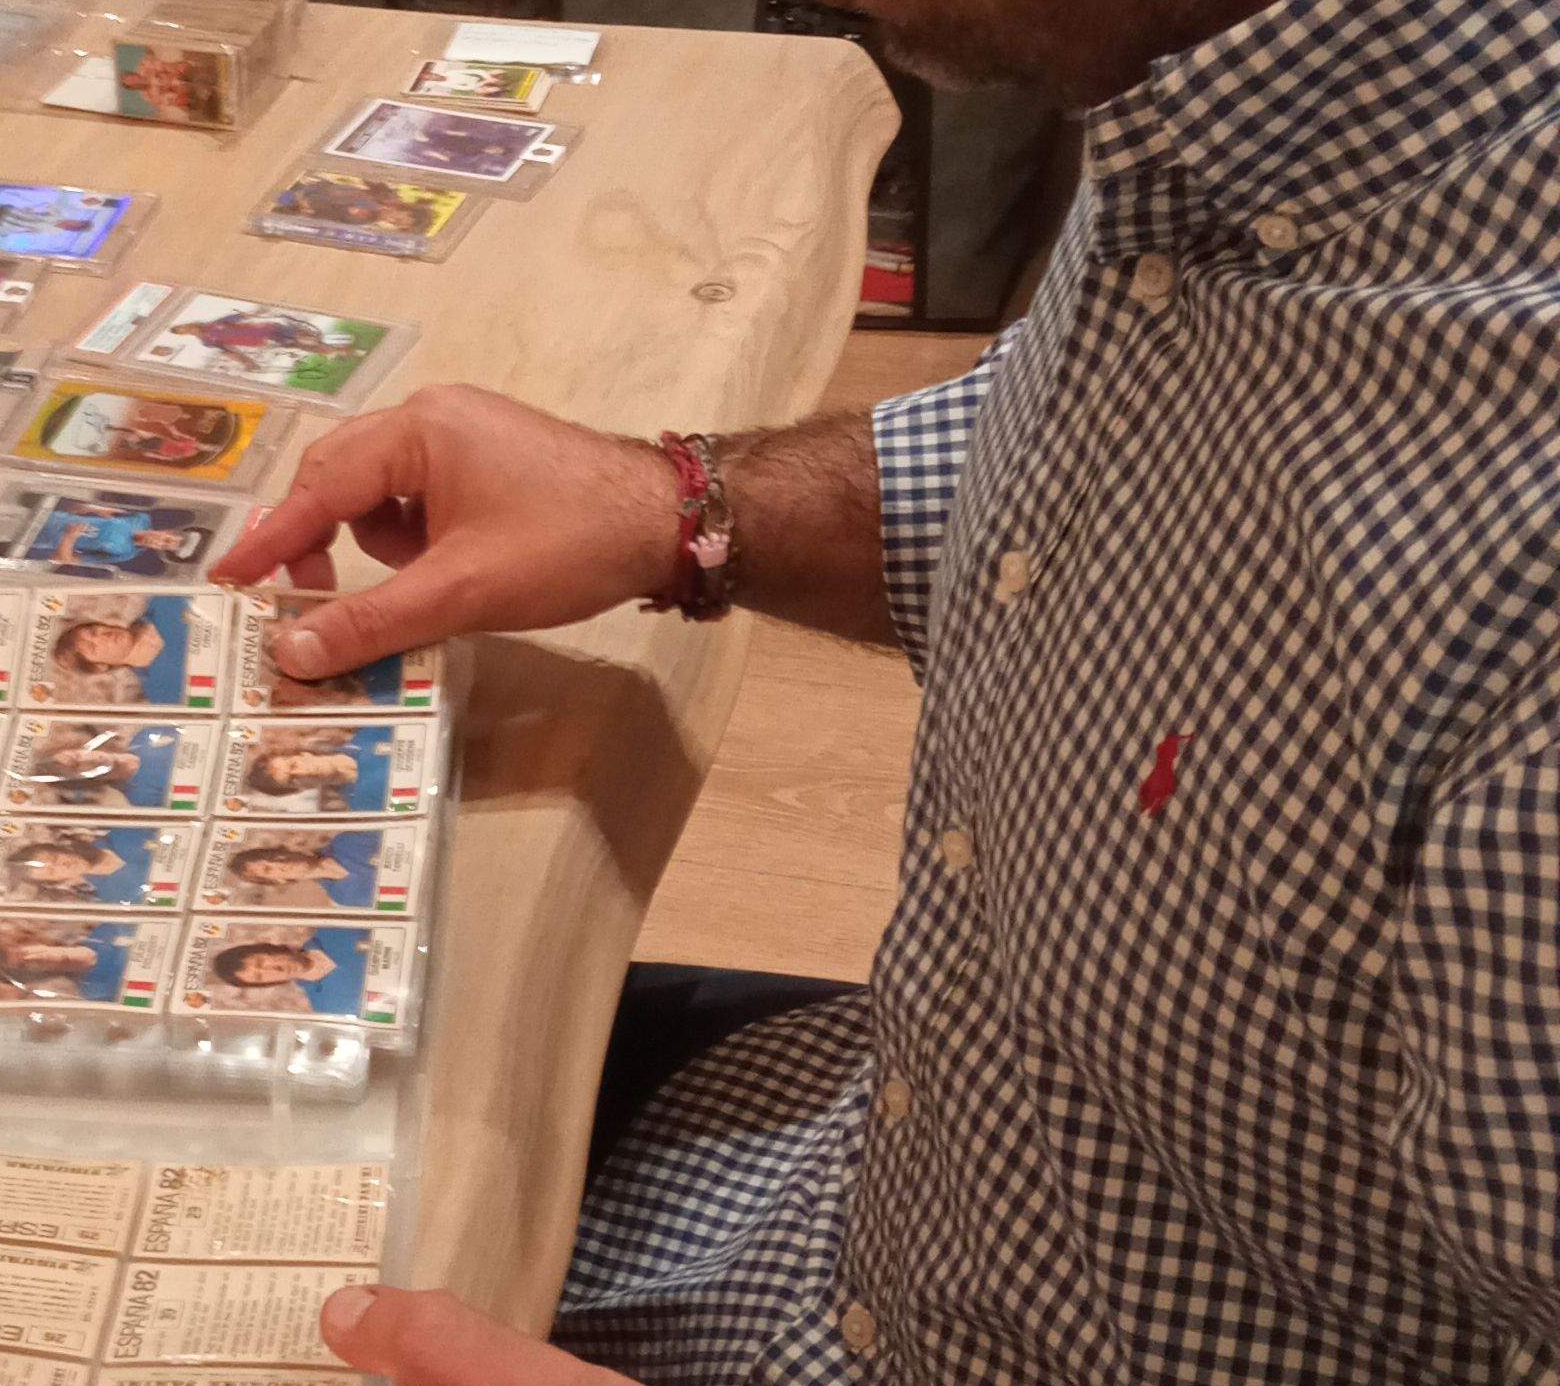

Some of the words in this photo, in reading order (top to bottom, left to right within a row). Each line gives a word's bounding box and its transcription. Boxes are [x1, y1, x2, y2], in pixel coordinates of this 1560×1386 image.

[37, 616, 51, 629] 82
[245, 615, 259, 631] 82
[28, 636, 48, 681] ESPAÑA
[241, 636, 257, 687] ESPAÑA
[223, 759, 242, 795] ESPAÑA
[184, 952, 205, 990] ESPAÑA
[145, 1194, 177, 1252] ESPAÑA
[132, 1271, 159, 1291] 82
[115, 1296, 151, 1358] ESPAÑA
